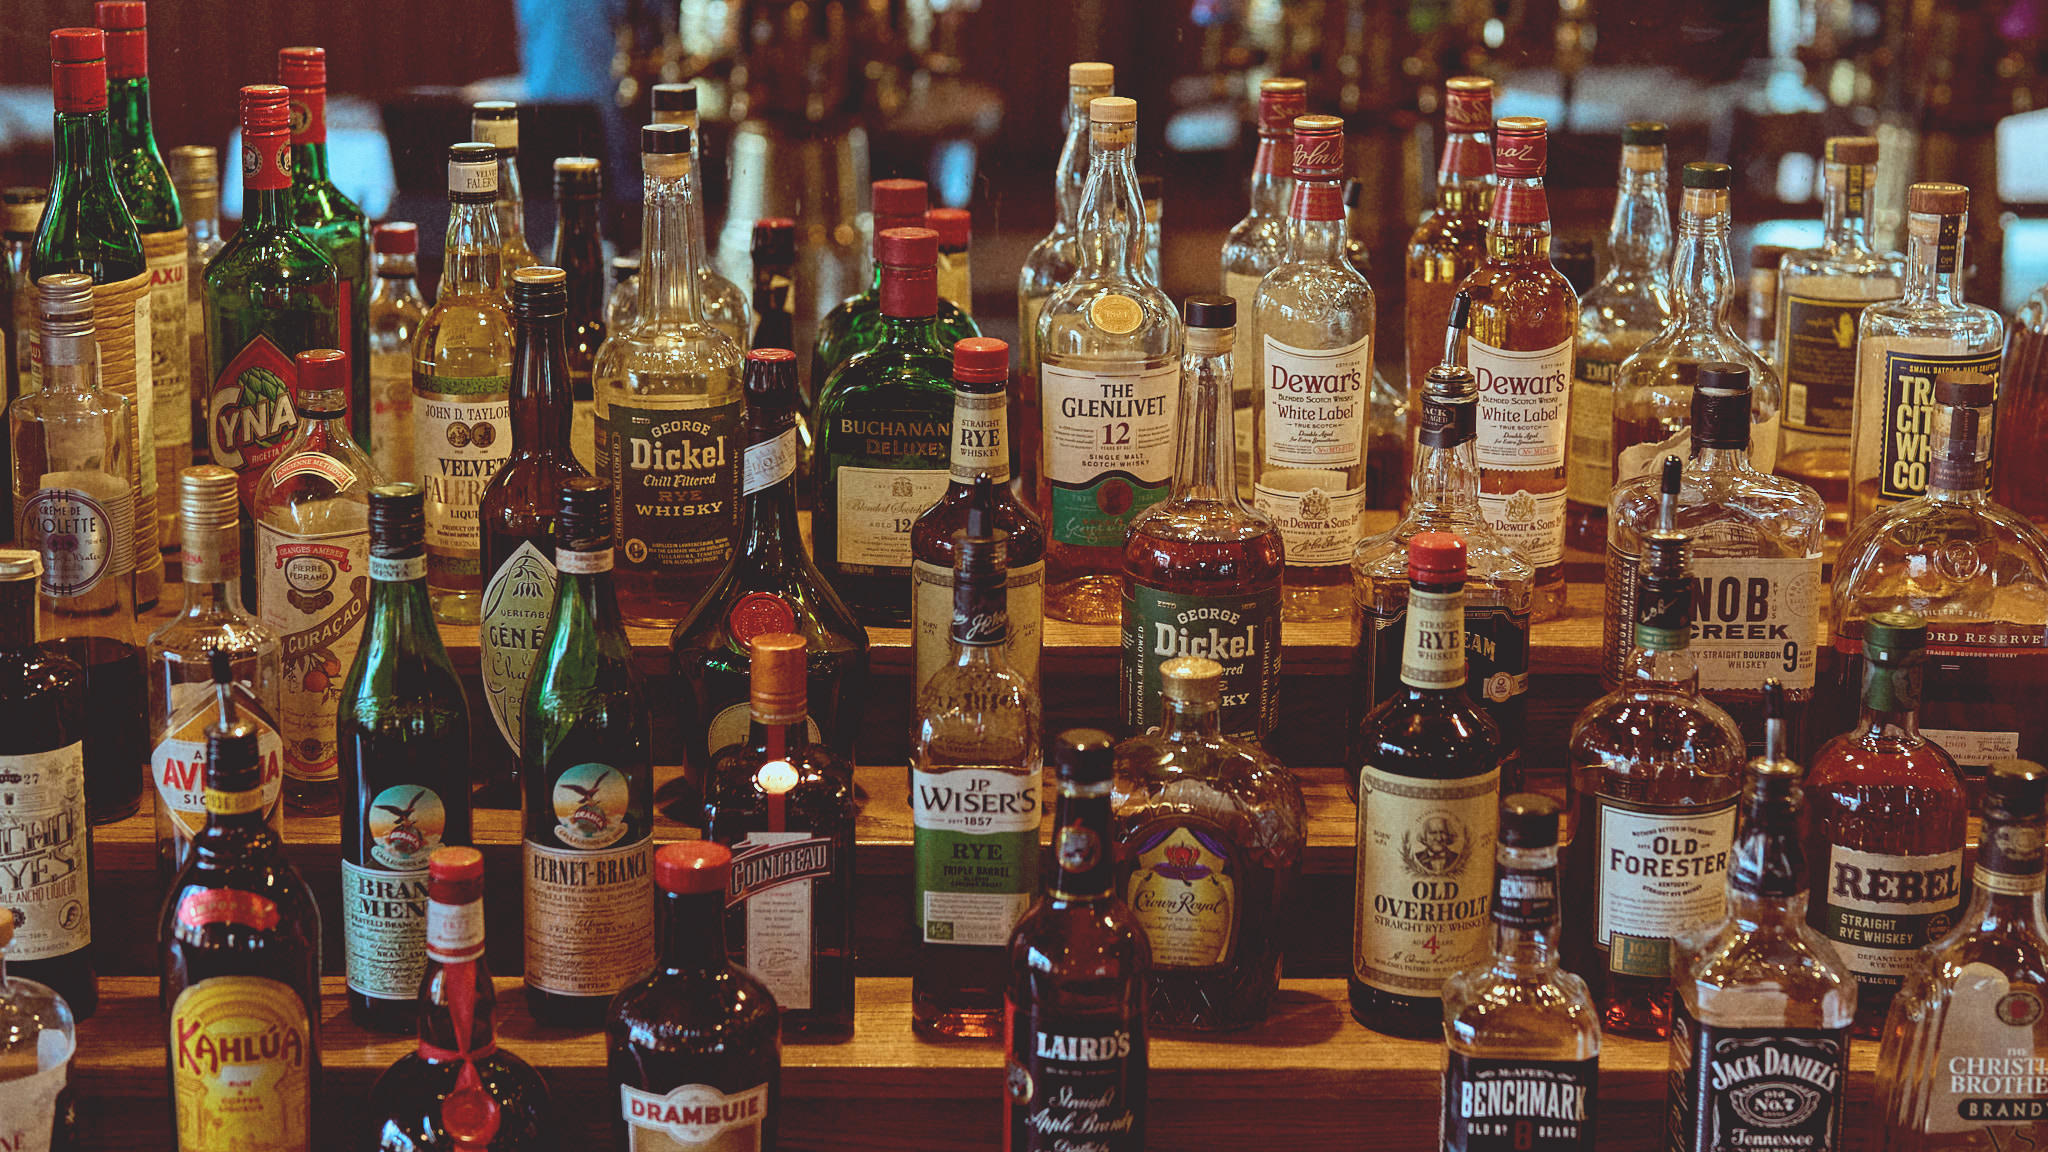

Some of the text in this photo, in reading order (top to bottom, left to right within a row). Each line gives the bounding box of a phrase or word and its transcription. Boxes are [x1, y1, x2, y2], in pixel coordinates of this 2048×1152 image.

[1910, 364, 1931, 374] SMALL
[1272, 365, 1361, 393] Dewar's
[1476, 367, 1566, 395] Dewar's
[1100, 384, 1134, 398] THE
[1278, 394, 1304, 402] BLENDED
[1306, 395, 1332, 403] SCOTCH
[1483, 395, 1509, 404] BLENDED
[1511, 397, 1536, 405] SCOTCH
[425, 405, 464, 421] JOHN D.
[1062, 395, 1166, 418] GLENLIVET
[210, 387, 298, 468] CYNA
[651, 420, 711, 438] GEORGE
[841, 419, 950, 436] BUCHANAN
[961, 419, 1000, 428] STRAIGHT
[1896, 404, 1935, 435] CIT
[960, 429, 1000, 447] RYE
[1102, 422, 1131, 445] 12
[630, 436, 726, 470] Dickel
[961, 448, 1000, 457] WHISKEY
[439, 457, 507, 477] VELVET
[1120, 460, 1150, 468] WHISKY
[423, 474, 488, 505] FALER
[643, 473, 716, 488] Chill Filtered
[658, 490, 703, 502] RYE
[71, 506, 81, 516] DE
[635, 501, 724, 517] WHISKY
[28, 516, 96, 534] VIOLETTE
[894, 519, 911, 533] 12
[1290, 517, 1321, 529] Dewar
[1324, 520, 1330, 529] &
[1331, 517, 1351, 529] Sons
[1496, 520, 1555, 531] Dewar & Sons
[289, 573, 329, 581] FERRAND
[293, 564, 322, 573] PIERRE
[1620, 561, 1631, 616] WHISKEY
[1690, 577, 1769, 622] NOB
[1177, 608, 1240, 625] GEORGE
[288, 599, 361, 654] CURAÇAO
[490, 622, 544, 651] GÉNÉ
[1154, 622, 1256, 660] Dickel
[1418, 630, 1459, 650] RYE
[1966, 632, 2041, 645] RESERVE
[1418, 650, 1459, 661] WHISKEY
[1464, 632, 1496, 662] EAM
[1703, 651, 1781, 659] STRAIGHT BOURBON
[1728, 661, 1768, 669] WHISKEY
[1783, 641, 1799, 673] 9
[920, 785, 1036, 813] WISER'S
[964, 817, 993, 827] 1857
[951, 843, 1003, 861] RYE
[1652, 836, 1698, 855] OLD
[534, 851, 647, 886] FERNET-BRANCA
[731, 845, 827, 895] COINTREAU
[943, 865, 973, 876] TRIPLE
[1610, 848, 1727, 877] FORESTER
[359, 879, 430, 898] BRAN
[1412, 881, 1459, 900] OLD
[1832, 860, 1960, 905] REBEL
[16, 887, 44, 904] ANCHO
[1135, 890, 1226, 916] Crown Royal
[359, 899, 425, 918] MEN
[1374, 894, 1488, 921] OVERHOLT
[1374, 915, 1421, 932] STRAIGHT
[1425, 923, 1444, 933] RYE
[1840, 913, 1897, 931] STRAIGHT
[1839, 926, 1914, 945] RYE WHISKEY
[1422, 936, 1441, 955] 4
[177, 1017, 302, 1076] KAHLÚA
[1036, 1029, 1131, 1062] LAIRD'S
[1711, 1047, 1840, 1092] JACK DANIEL'S
[1949, 1056, 2048, 1075] CHRISTI
[1951, 1075, 2048, 1094] BROTHE
[1461, 1079, 1587, 1121] BENCHMARK
[1969, 1102, 2048, 1117] BRAND
[631, 1096, 759, 1125] DRAMBUIE
[1468, 1123, 1577, 1138] OLD BRAND
[1731, 1128, 1814, 1146] Tennessee
